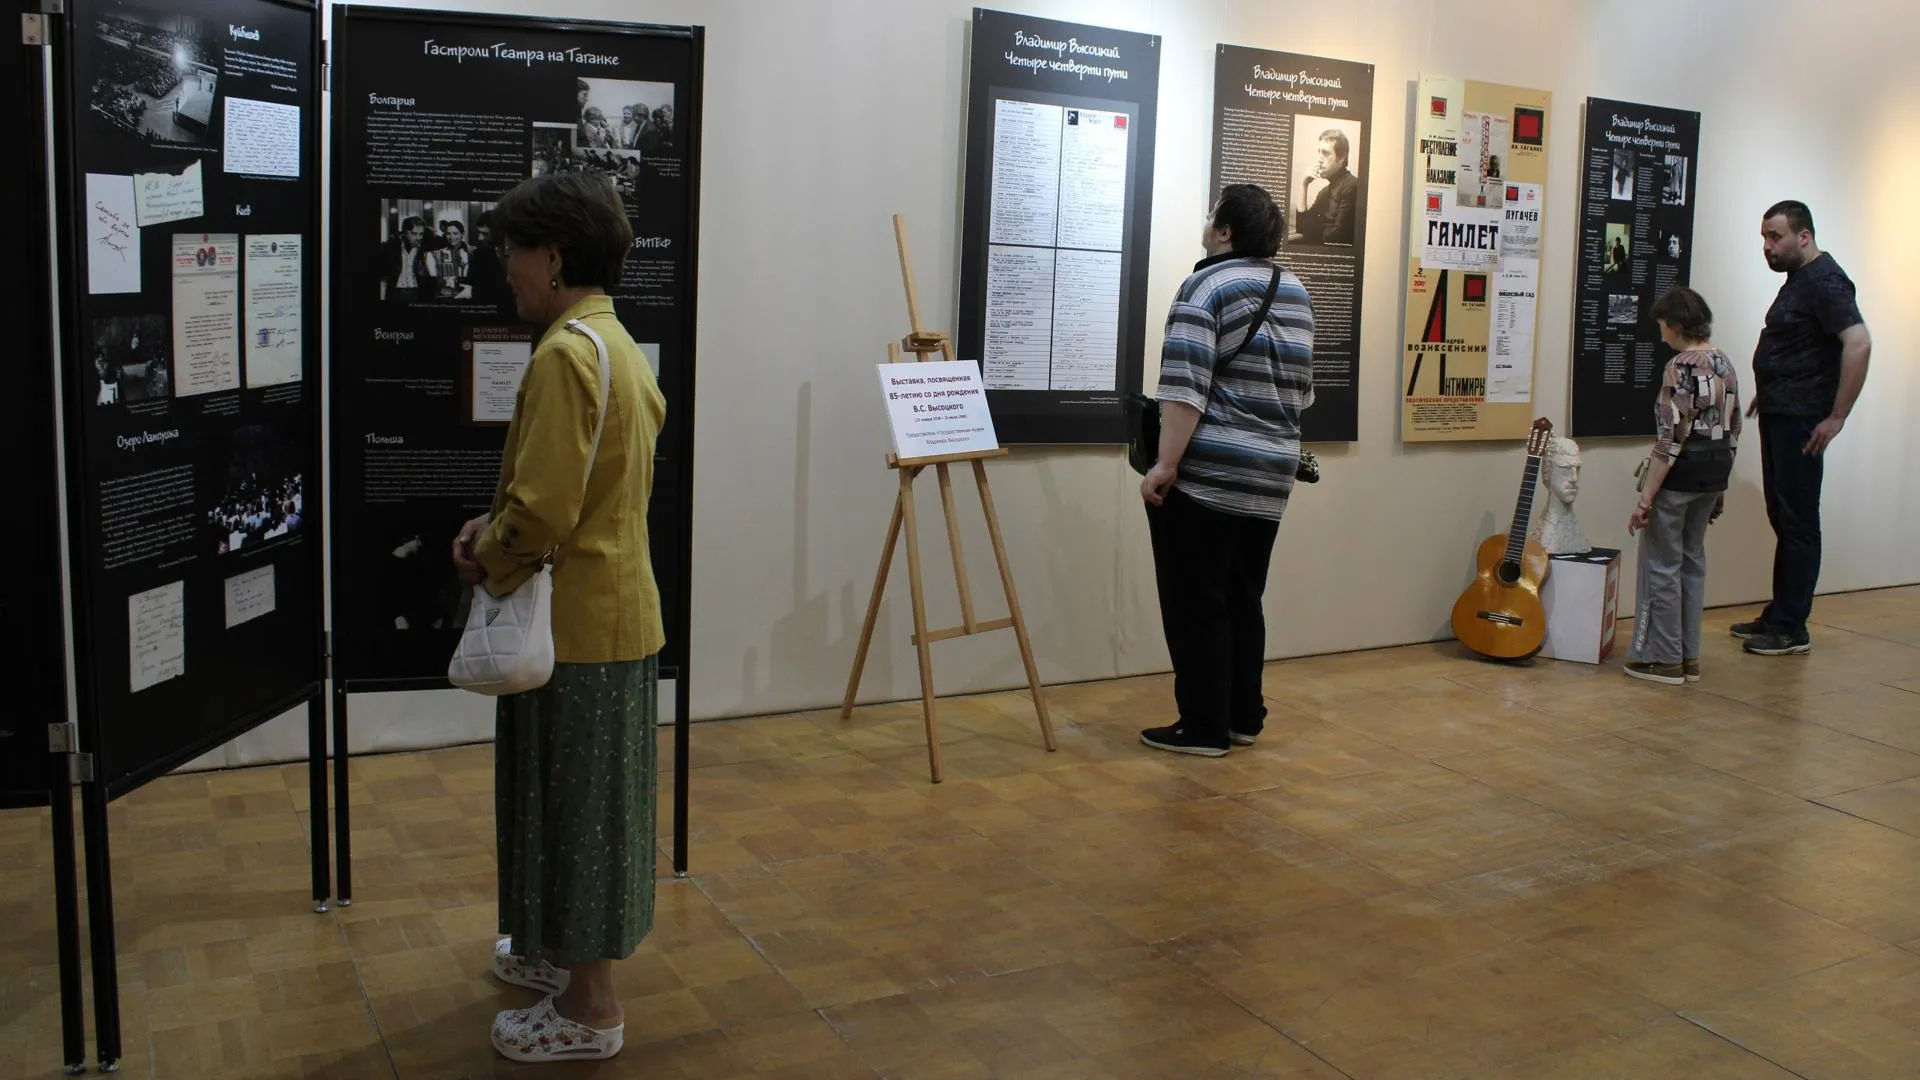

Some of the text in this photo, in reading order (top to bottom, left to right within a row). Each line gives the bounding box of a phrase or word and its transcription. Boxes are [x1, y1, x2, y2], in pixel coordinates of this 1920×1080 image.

[424, 39, 620, 67] Гастроли Театра на Таганке
[1015, 30, 1121, 59] Владимир Высоцкий
[1005, 51, 1128, 84] Четыре четверти пути
[1253, 64, 1342, 89] Владимир Высоцкий
[368, 92, 415, 111] Болгария
[1244, 83, 1348, 112] Четыре четверти пути
[1612, 114, 1676, 135] Владимир Высоцкий
[1605, 130, 1680, 153] Четыре четверти пути
[1505, 210, 1539, 222] ПУГАЧЕВ
[635, 237, 672, 248] БИТЕФ
[1427, 220, 1499, 250] ГАМЛЕТ
[374, 327, 414, 345] Венгрия
[1407, 344, 1487, 352] ВОЗНЕСЕНСКИЙ
[889, 391, 923, 400] 85-летию
[933, 390, 945, 399] дня
[946, 388, 979, 398] рождения
[913, 403, 964, 413] В.С. Высоцкого
[117, 435, 142, 452] Озеро
[364, 432, 404, 444] Польша
